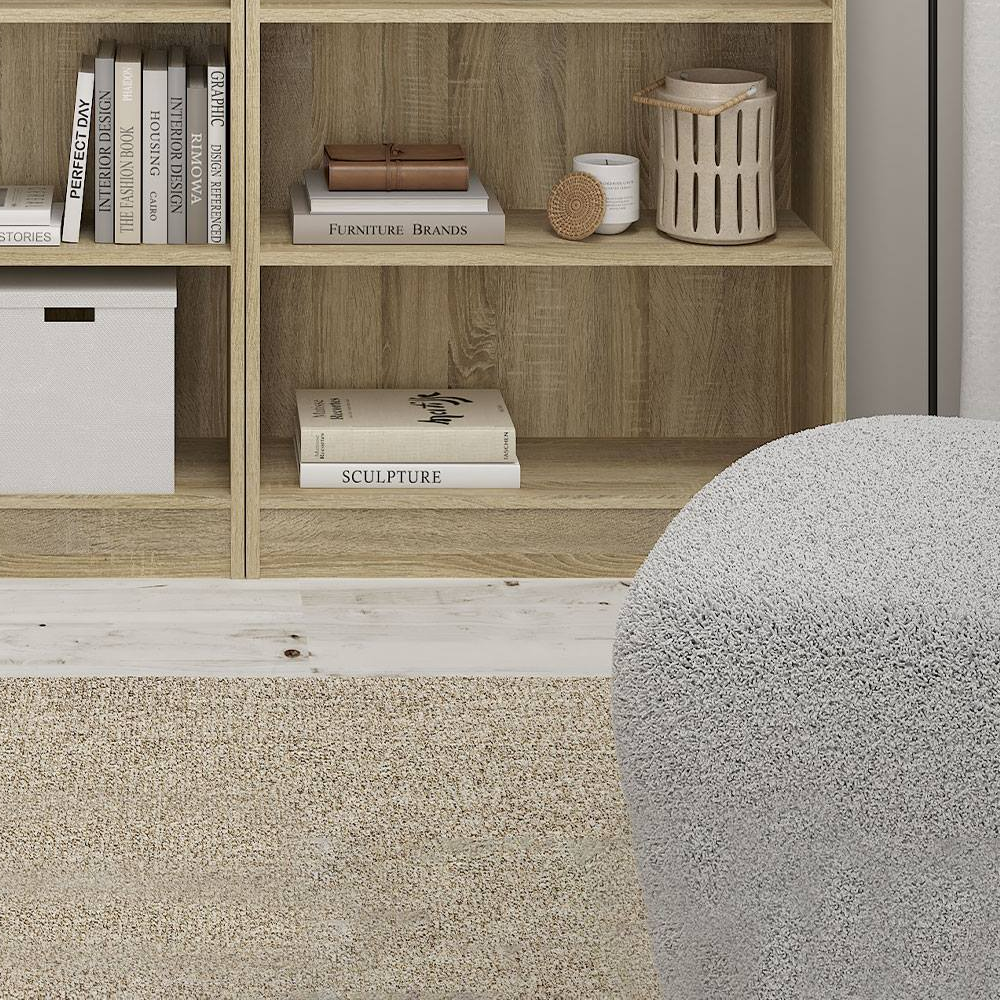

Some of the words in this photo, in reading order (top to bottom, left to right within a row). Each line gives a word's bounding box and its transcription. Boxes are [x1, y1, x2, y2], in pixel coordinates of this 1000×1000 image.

[77, 98, 91, 129] DAY
[98, 90, 112, 144] DESIGN
[210, 70, 225, 128] GRAPHIC
[119, 125, 135, 157] BOOK
[150, 110, 161, 177] HOUSING
[170, 97, 183, 160] INTERIOR
[69, 131, 87, 200] PERFECT
[98, 147, 111, 213] INTERIOR
[119, 160, 135, 208] FASHION
[170, 165, 183, 214] DESIGN
[190, 133, 203, 205] RIMOWA
[119, 211, 134, 234] THE
[328, 223, 404, 236] FURNITURE
[412, 223, 468, 236] BRANDS
[342, 469, 442, 484] SCULPTURE
